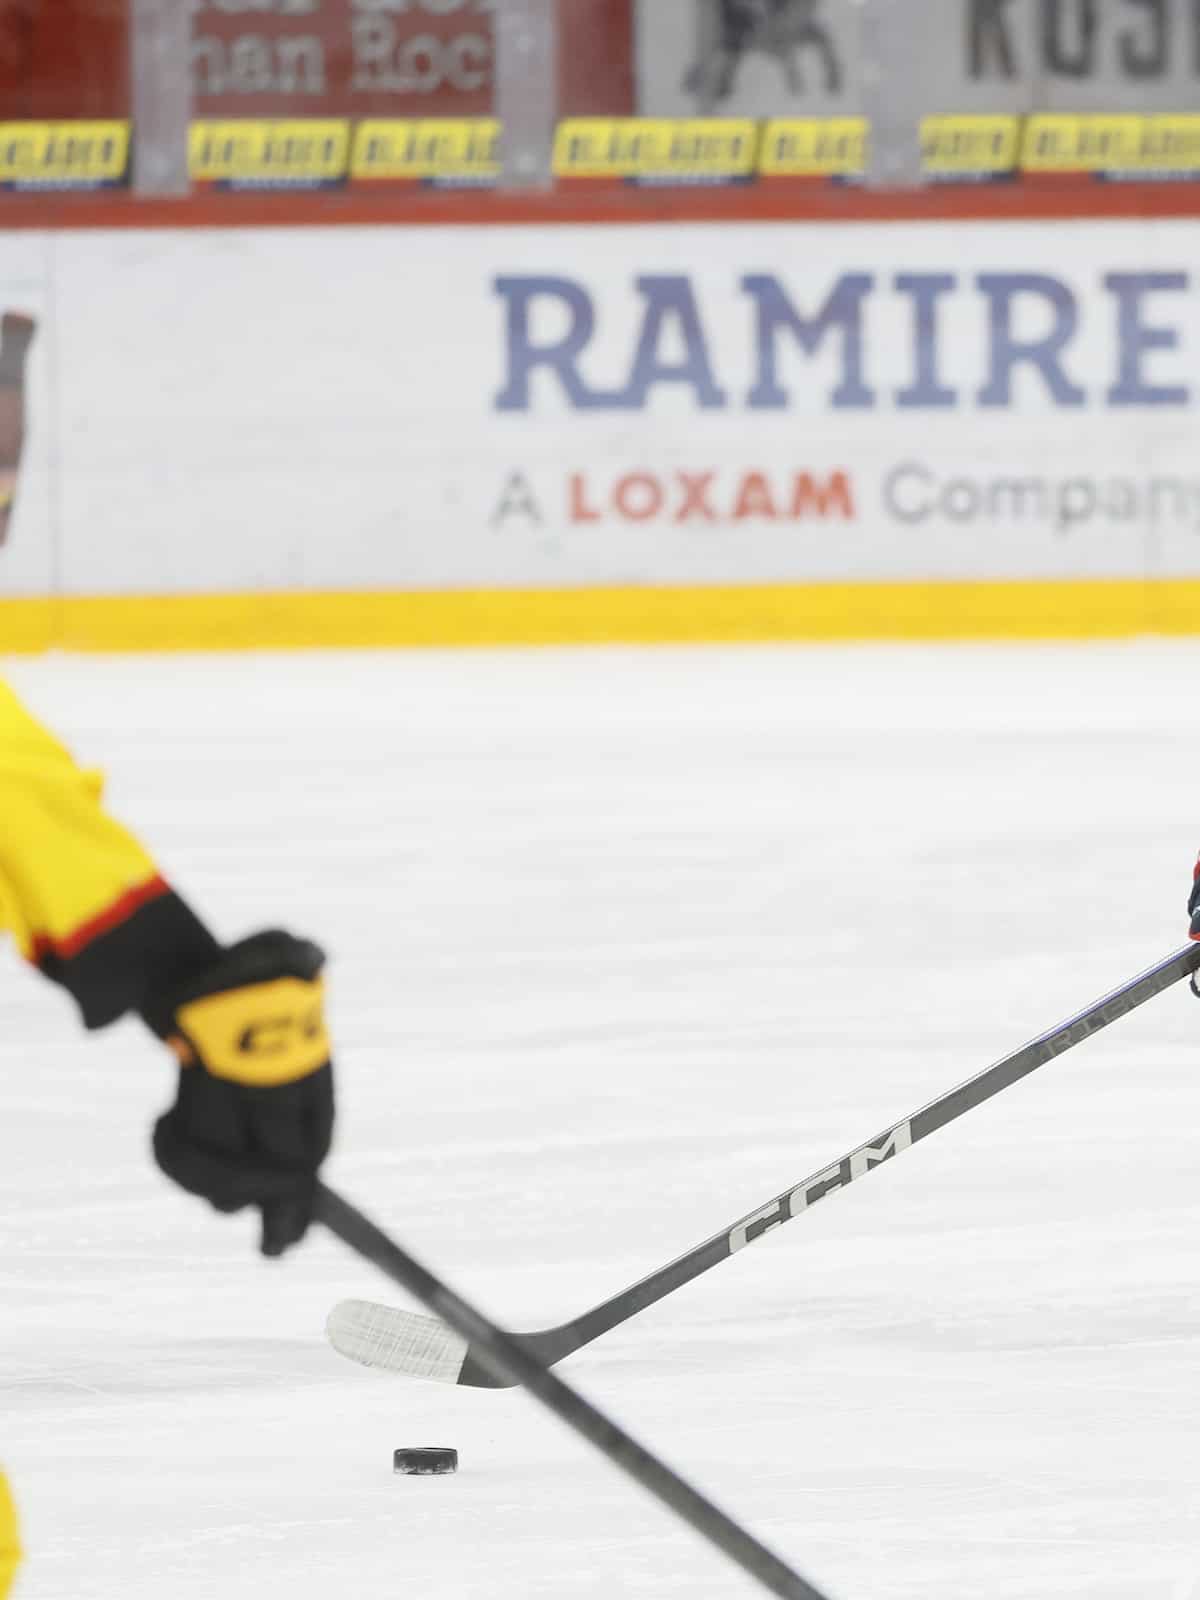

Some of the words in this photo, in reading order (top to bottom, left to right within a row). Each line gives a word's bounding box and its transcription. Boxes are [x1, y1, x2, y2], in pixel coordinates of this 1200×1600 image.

[491, 472, 543, 523] A
[568, 470, 856, 523] LOXAM
[729, 1118, 912, 1255] CCM
